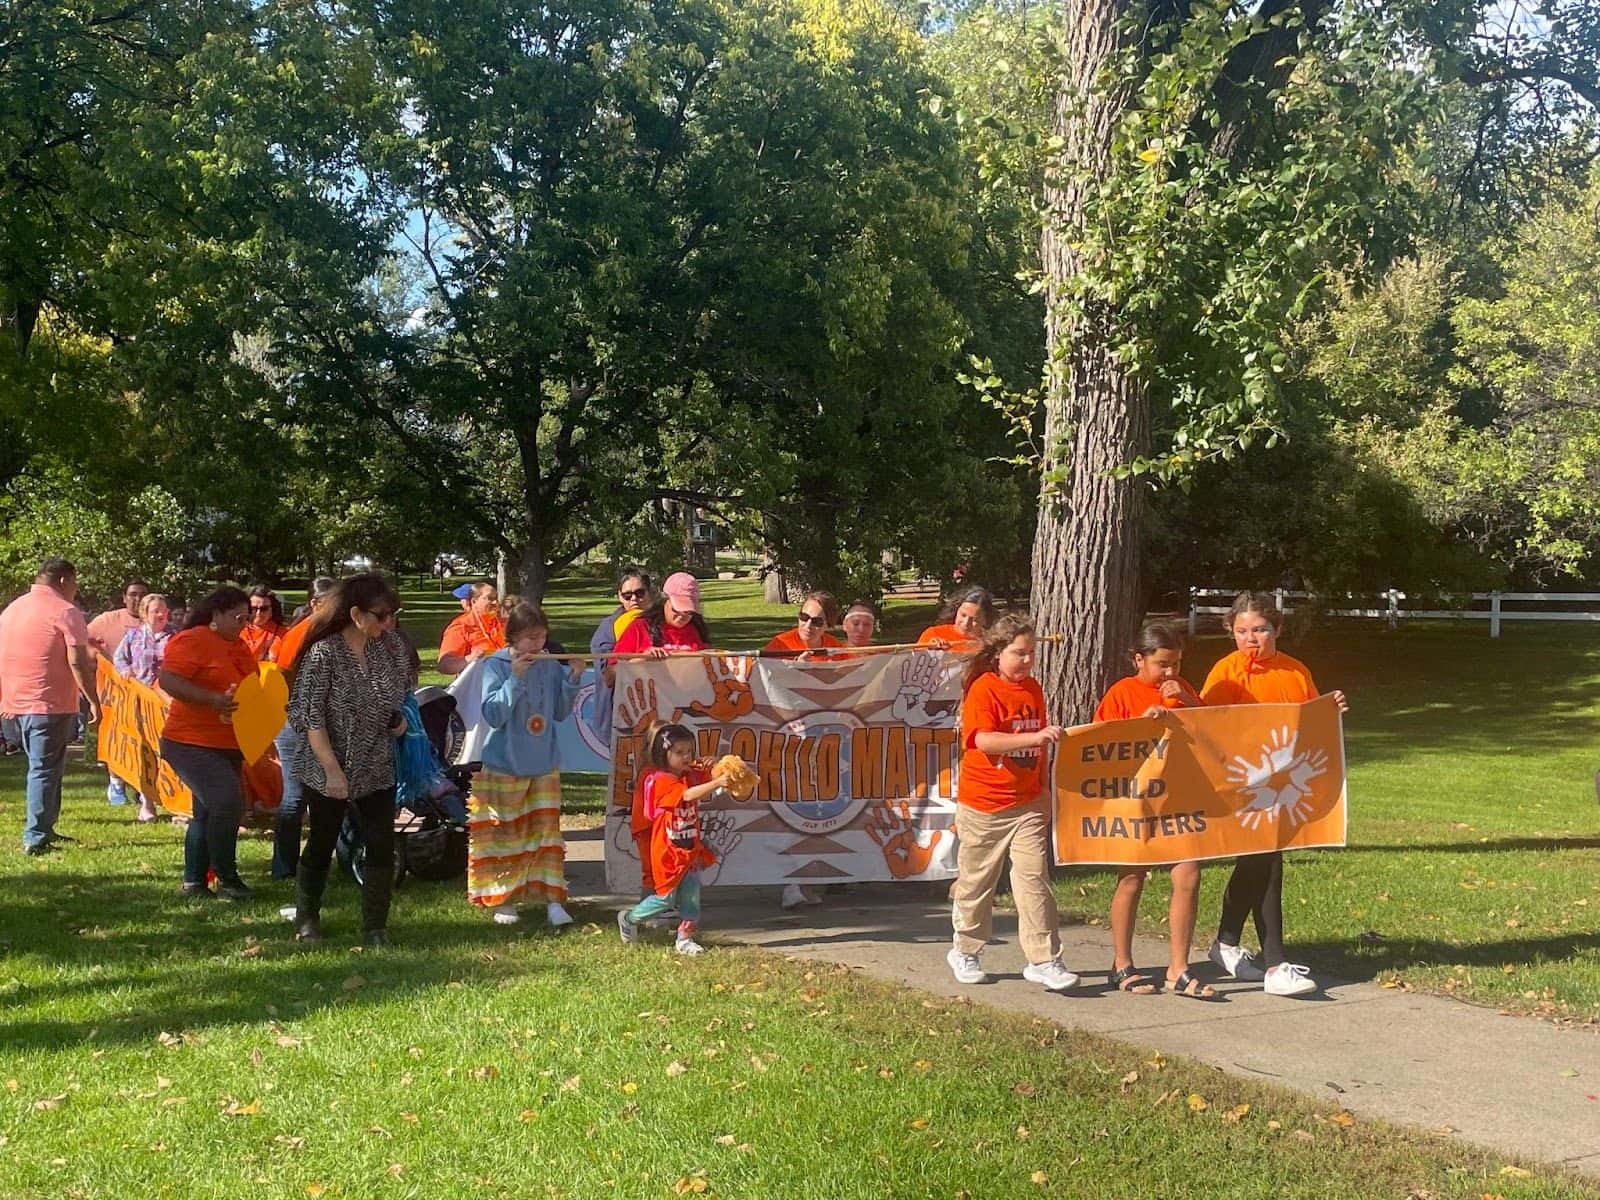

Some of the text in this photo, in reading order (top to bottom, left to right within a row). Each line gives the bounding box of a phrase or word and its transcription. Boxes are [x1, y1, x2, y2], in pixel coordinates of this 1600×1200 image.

[851, 726, 964, 800] MATT
[1081, 738, 1170, 762] EVERY
[1081, 776, 1167, 799] CHILD
[1081, 810, 1208, 840] MATTERS
